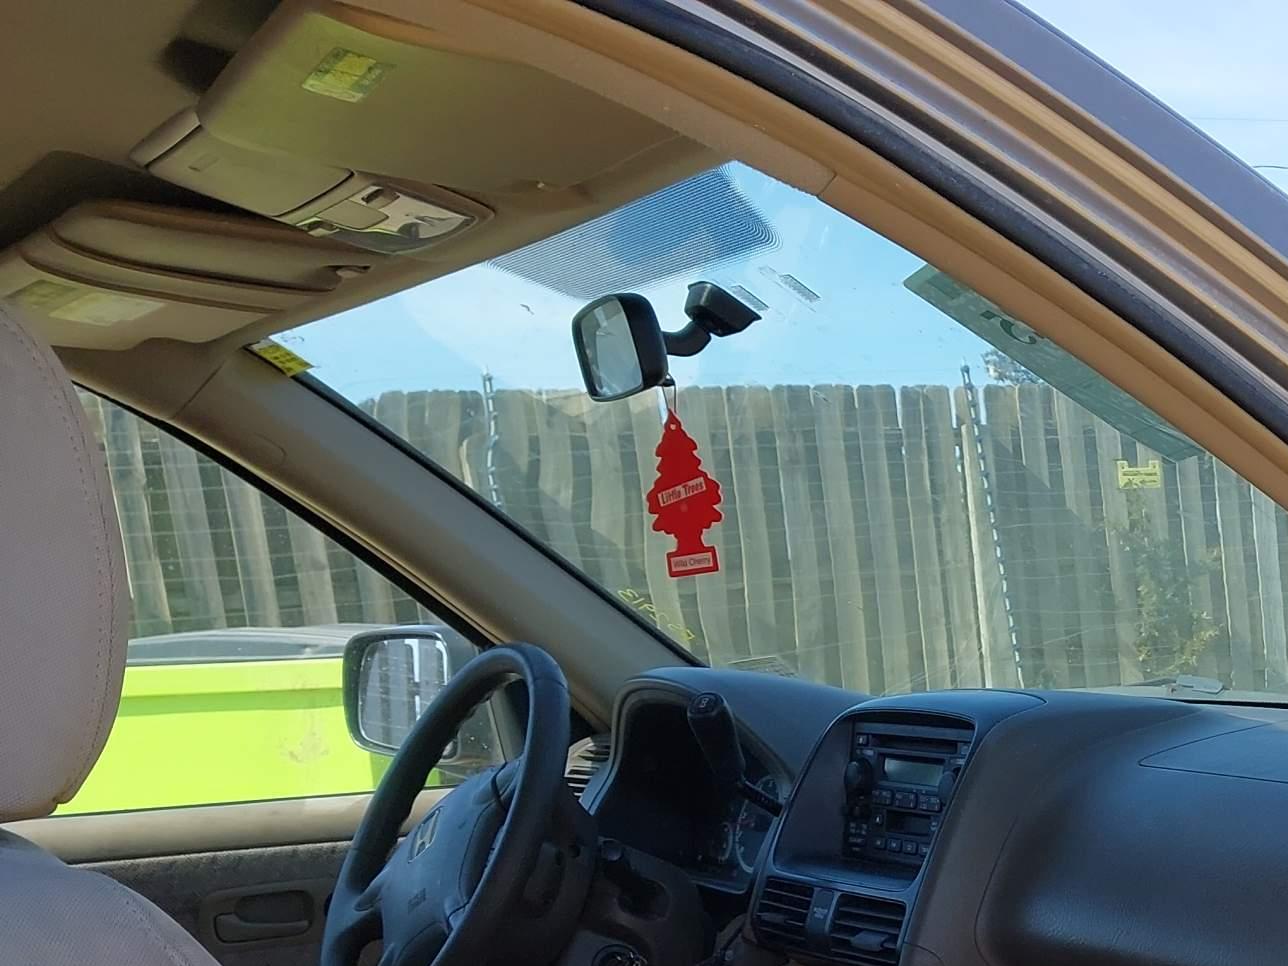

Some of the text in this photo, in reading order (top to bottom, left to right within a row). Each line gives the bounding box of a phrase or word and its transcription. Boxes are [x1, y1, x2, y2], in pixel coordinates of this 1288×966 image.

[661, 481, 704, 505] Little Trees
[673, 556, 711, 569] Wild Cherry
